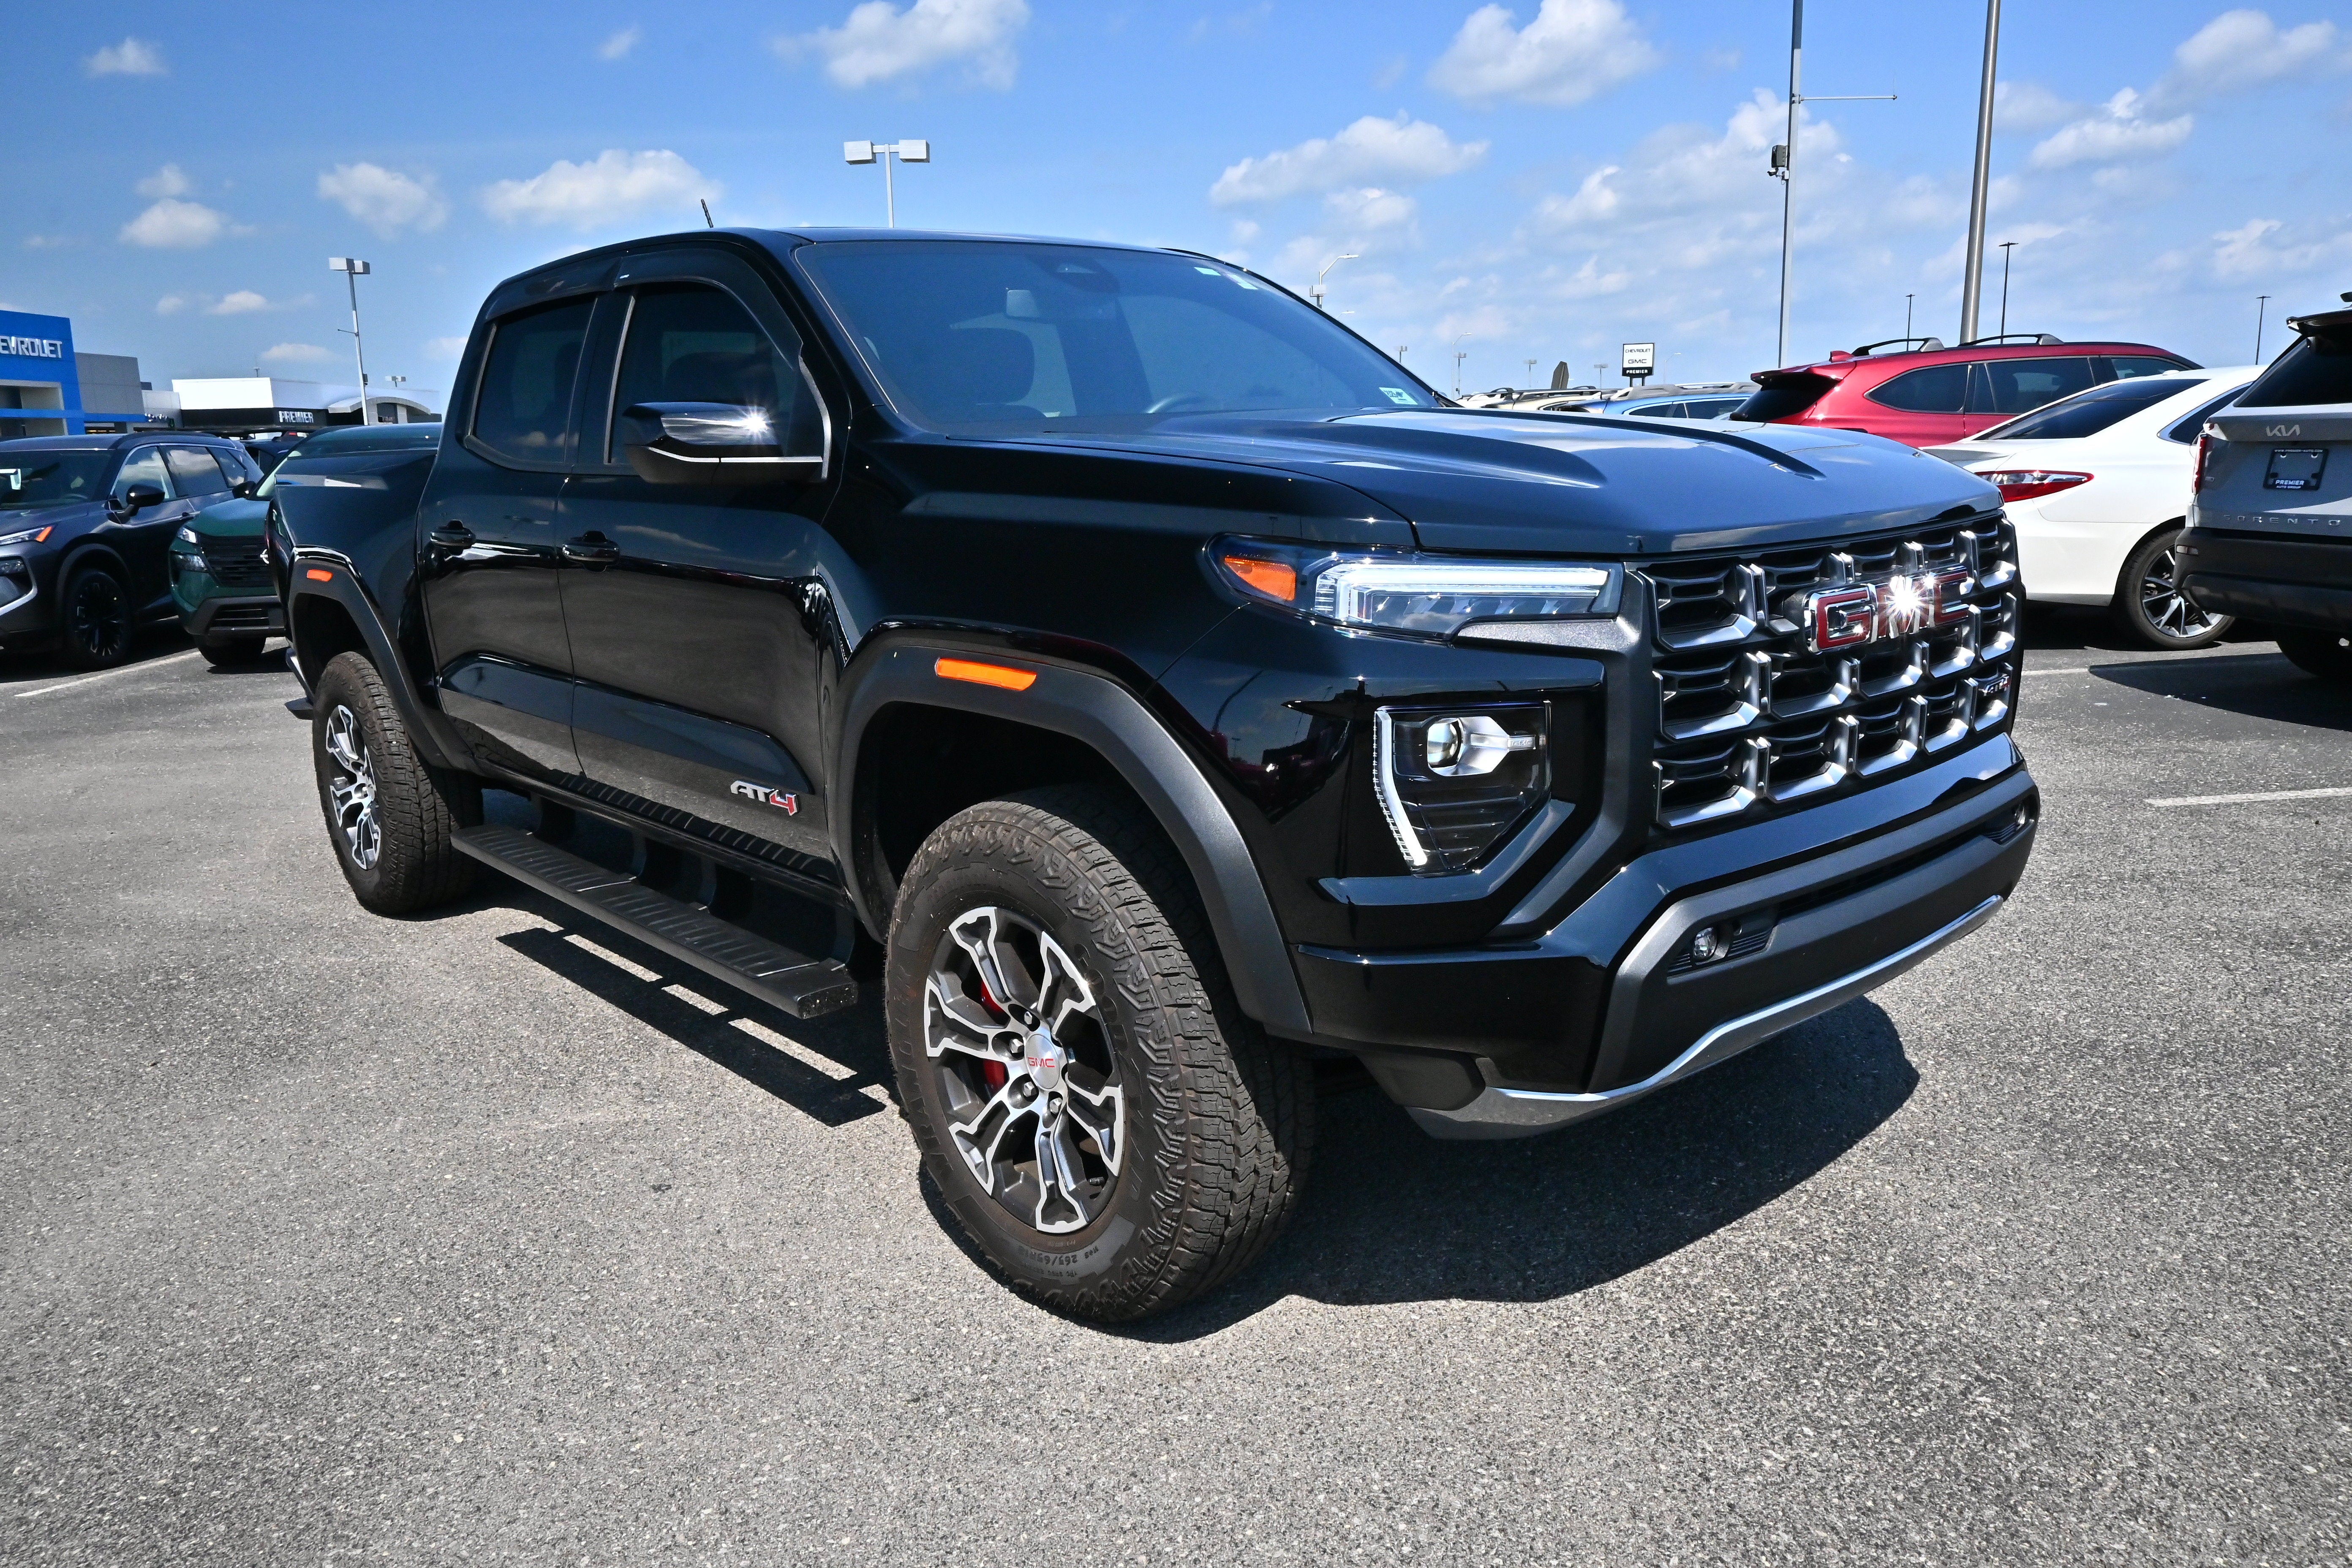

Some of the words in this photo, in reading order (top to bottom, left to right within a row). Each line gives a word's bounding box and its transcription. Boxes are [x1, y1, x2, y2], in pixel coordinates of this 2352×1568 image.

[279, 411, 313, 423] PREMIER
[2265, 425, 2300, 436] KIA
[2223, 514, 2341, 526] SORENTO
[1809, 567, 1970, 653] GMC
[730, 780, 798, 816] AT4
[1028, 1057, 1055, 1067] GMC
